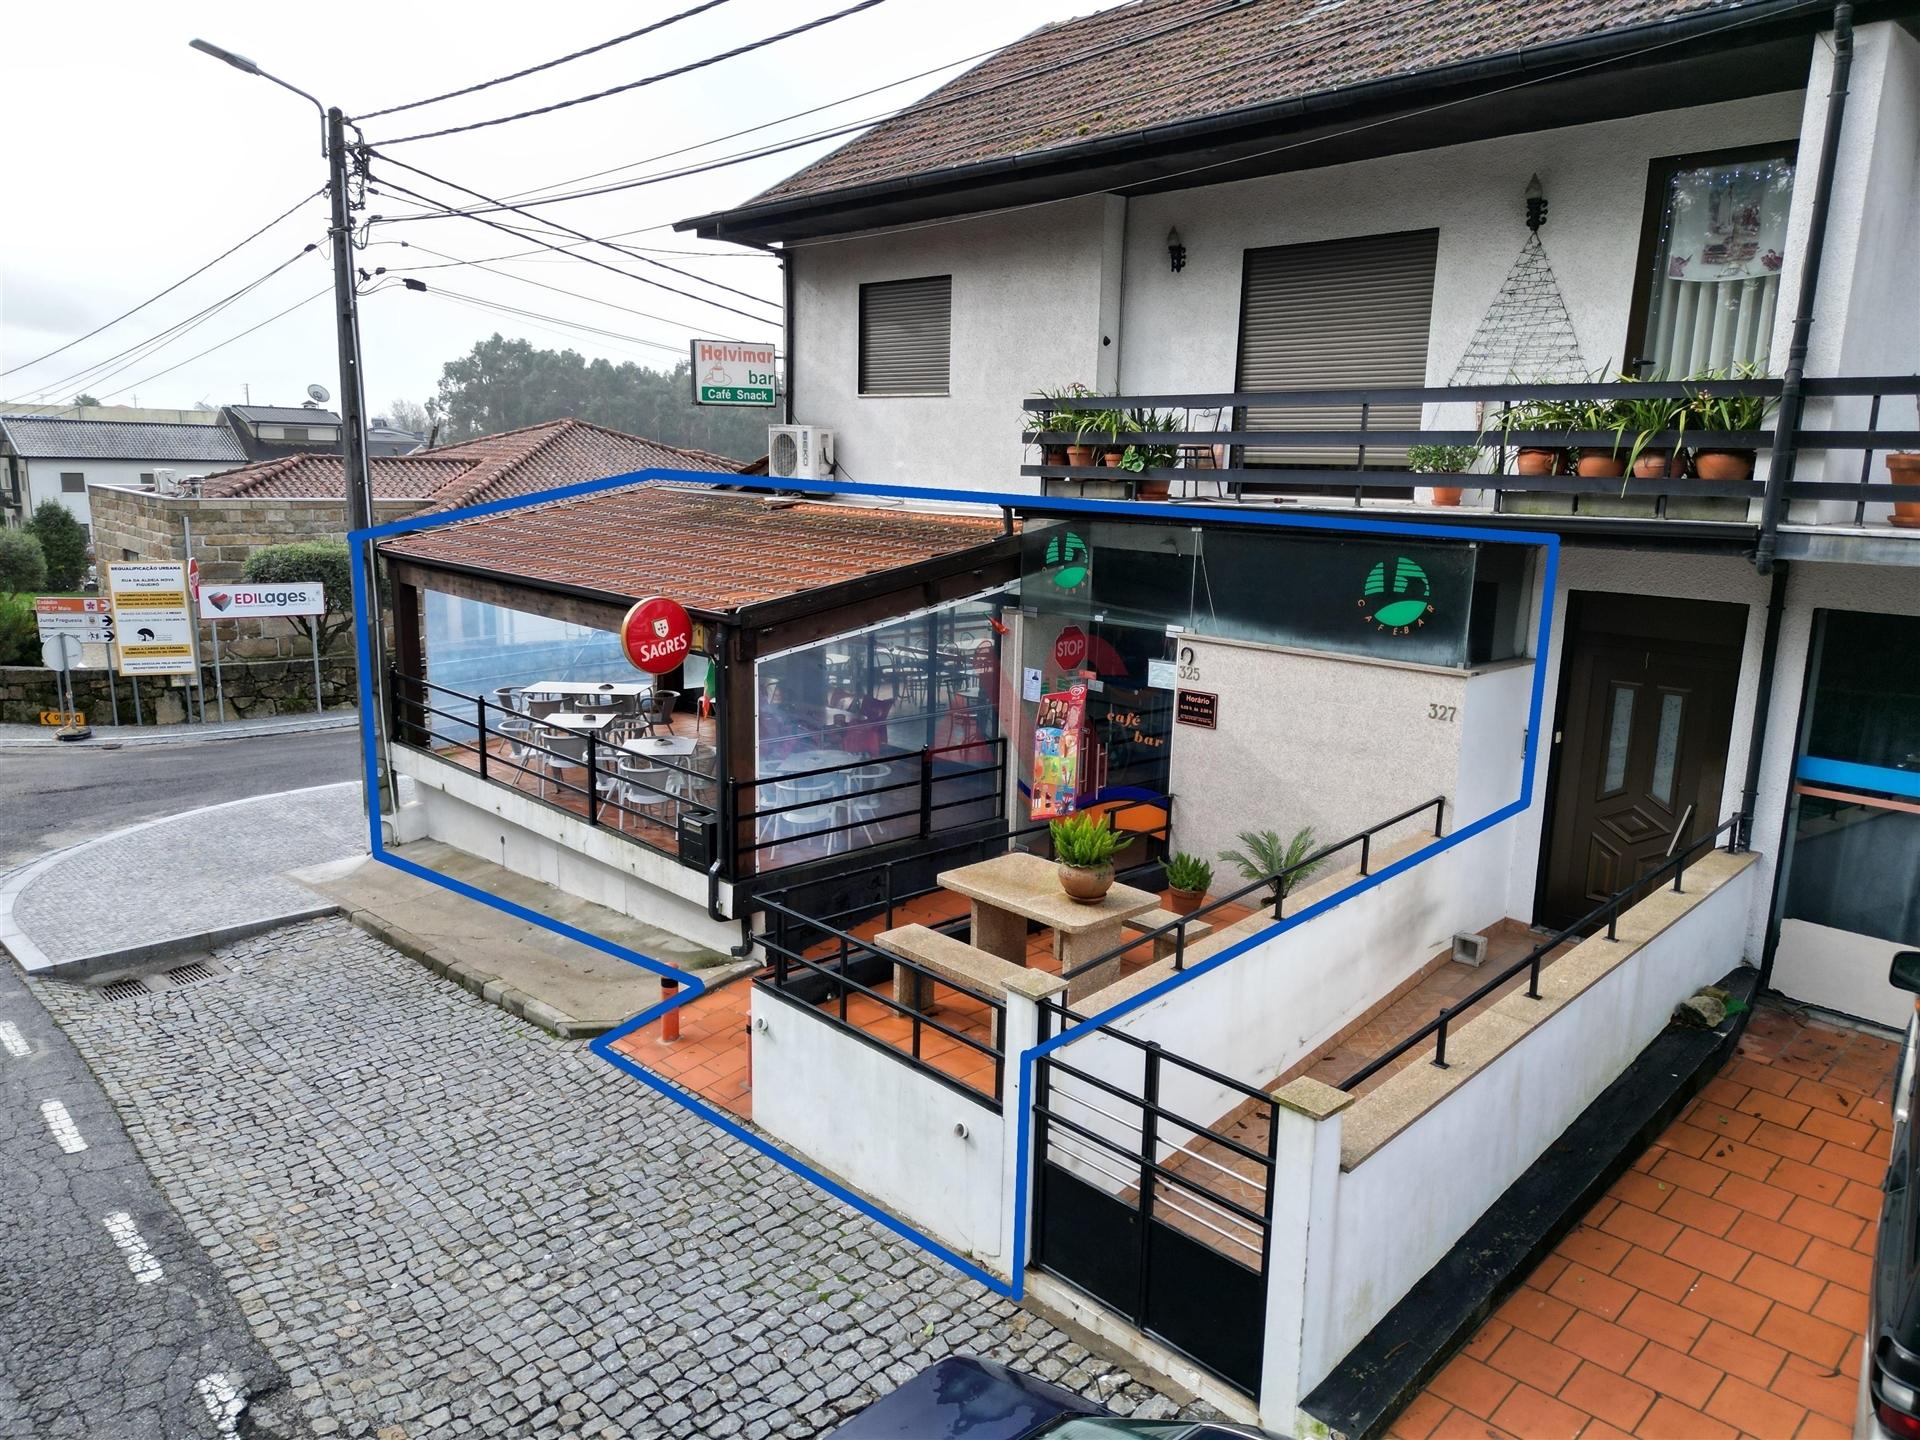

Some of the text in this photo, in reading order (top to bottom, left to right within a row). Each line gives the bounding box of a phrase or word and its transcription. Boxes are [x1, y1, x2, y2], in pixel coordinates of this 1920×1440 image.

[701, 345, 773, 363] Helvimar
[749, 370, 774, 385] bar
[708, 388, 768, 400] Café Snack
[640, 632, 687, 662] SAGRES
[1057, 640, 1084, 657] STOP
[1179, 666, 1200, 681] 325
[1186, 695, 1210, 705] Horário
[1107, 712, 1141, 727] café
[1428, 703, 1457, 722] 327
[1134, 730, 1164, 747] bar
